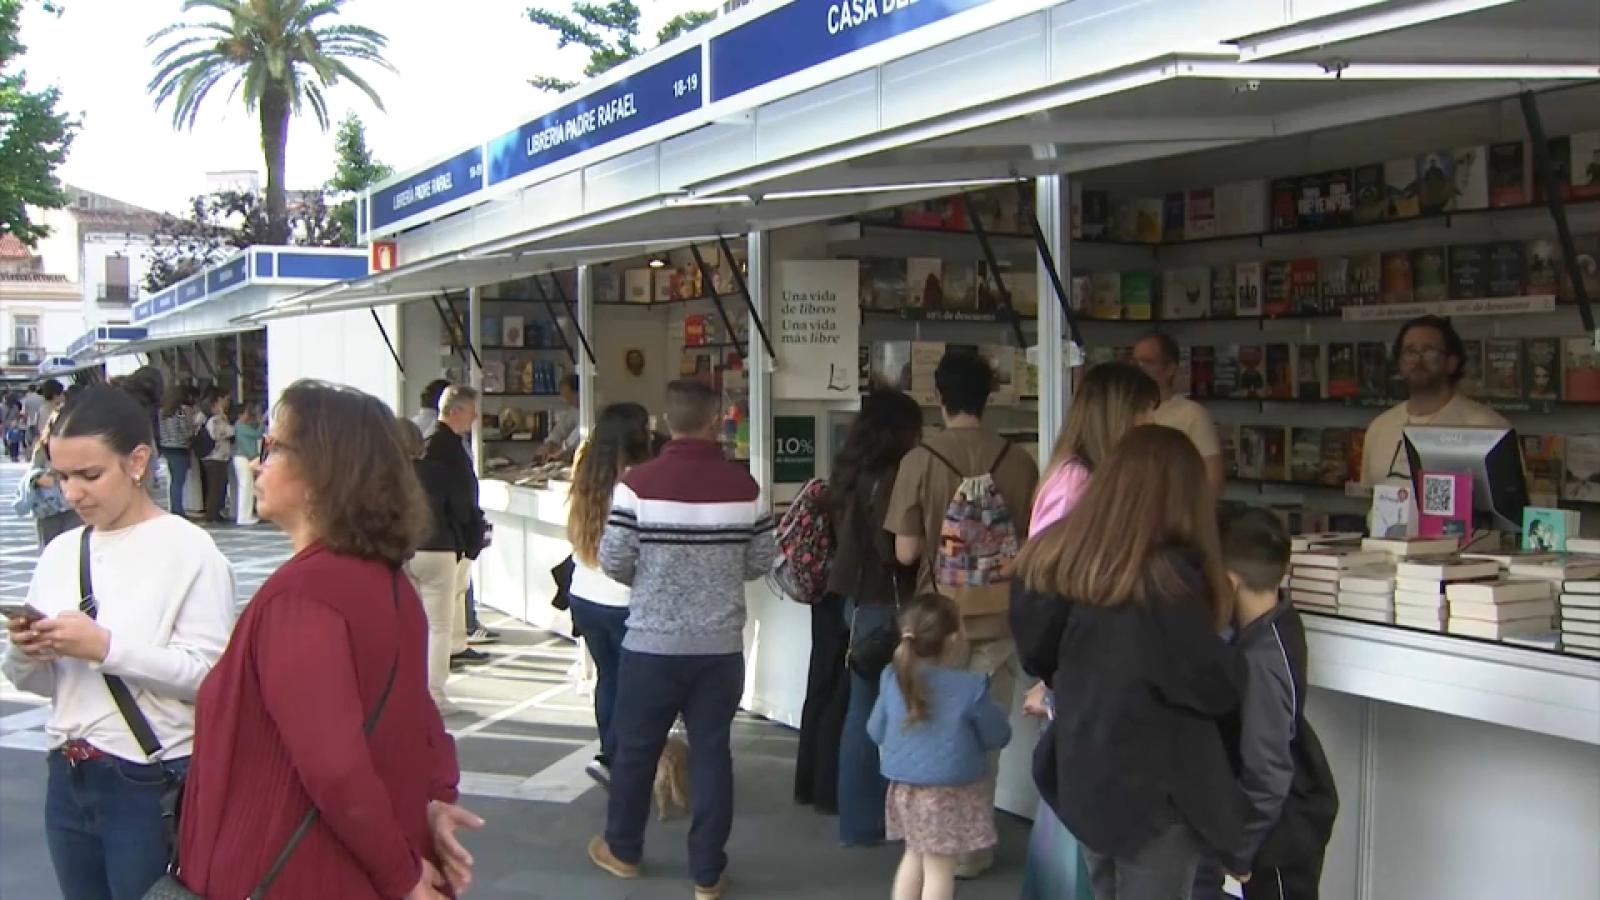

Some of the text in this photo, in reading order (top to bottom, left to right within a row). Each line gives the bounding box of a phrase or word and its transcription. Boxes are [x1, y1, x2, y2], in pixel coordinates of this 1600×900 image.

[827, 0, 878, 34] CASA
[527, 73, 698, 156] LIBRERÍA PADRE RAFAEL 18-19
[782, 289, 836, 301] Una vida
[781, 303, 837, 314] de libros
[782, 319, 836, 330] Una vida
[810, 332, 841, 344] libre
[776, 437, 814, 454] 10%
